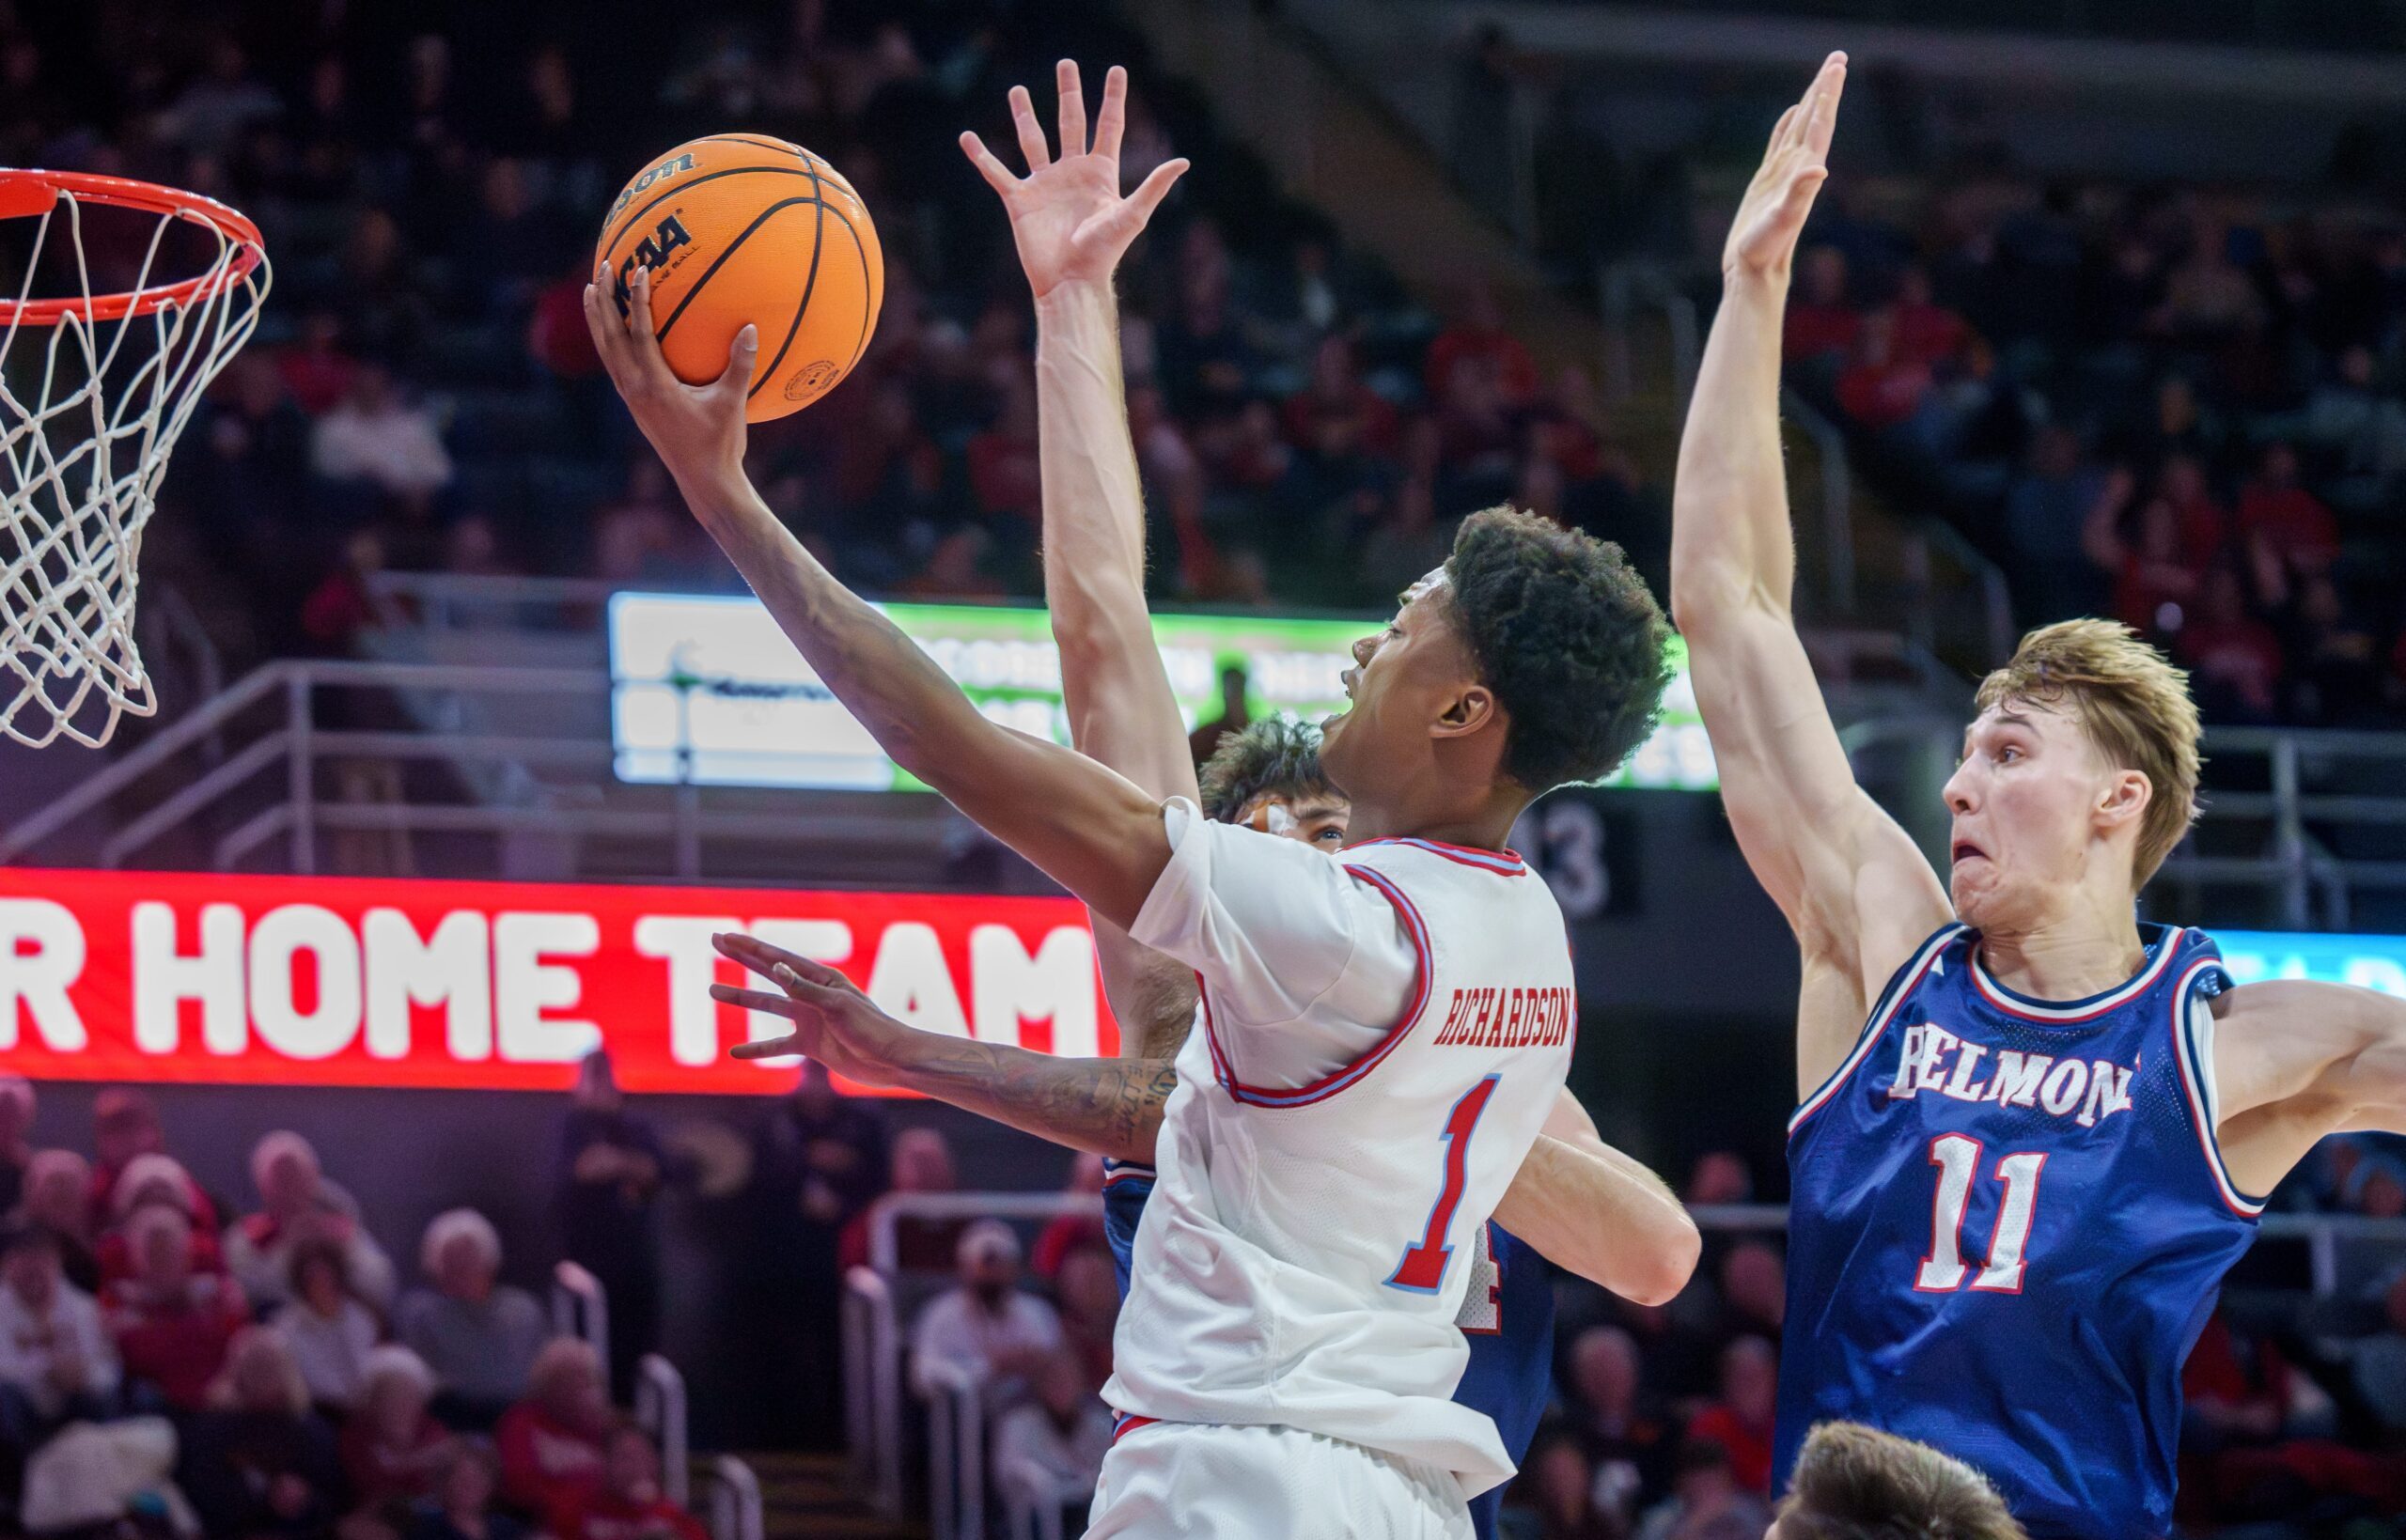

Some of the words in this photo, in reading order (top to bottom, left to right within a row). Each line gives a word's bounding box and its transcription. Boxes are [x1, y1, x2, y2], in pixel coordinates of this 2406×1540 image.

[605, 152, 695, 226] son
[132, 901, 601, 1063] HOME
[633, 914, 1098, 1066] TEAM
[1433, 988, 1571, 1048] RICHARDSON
[1888, 1021, 2141, 1128] BELMON
[1384, 1073, 1501, 1295] 1
[1912, 1131, 2050, 1295] 11
